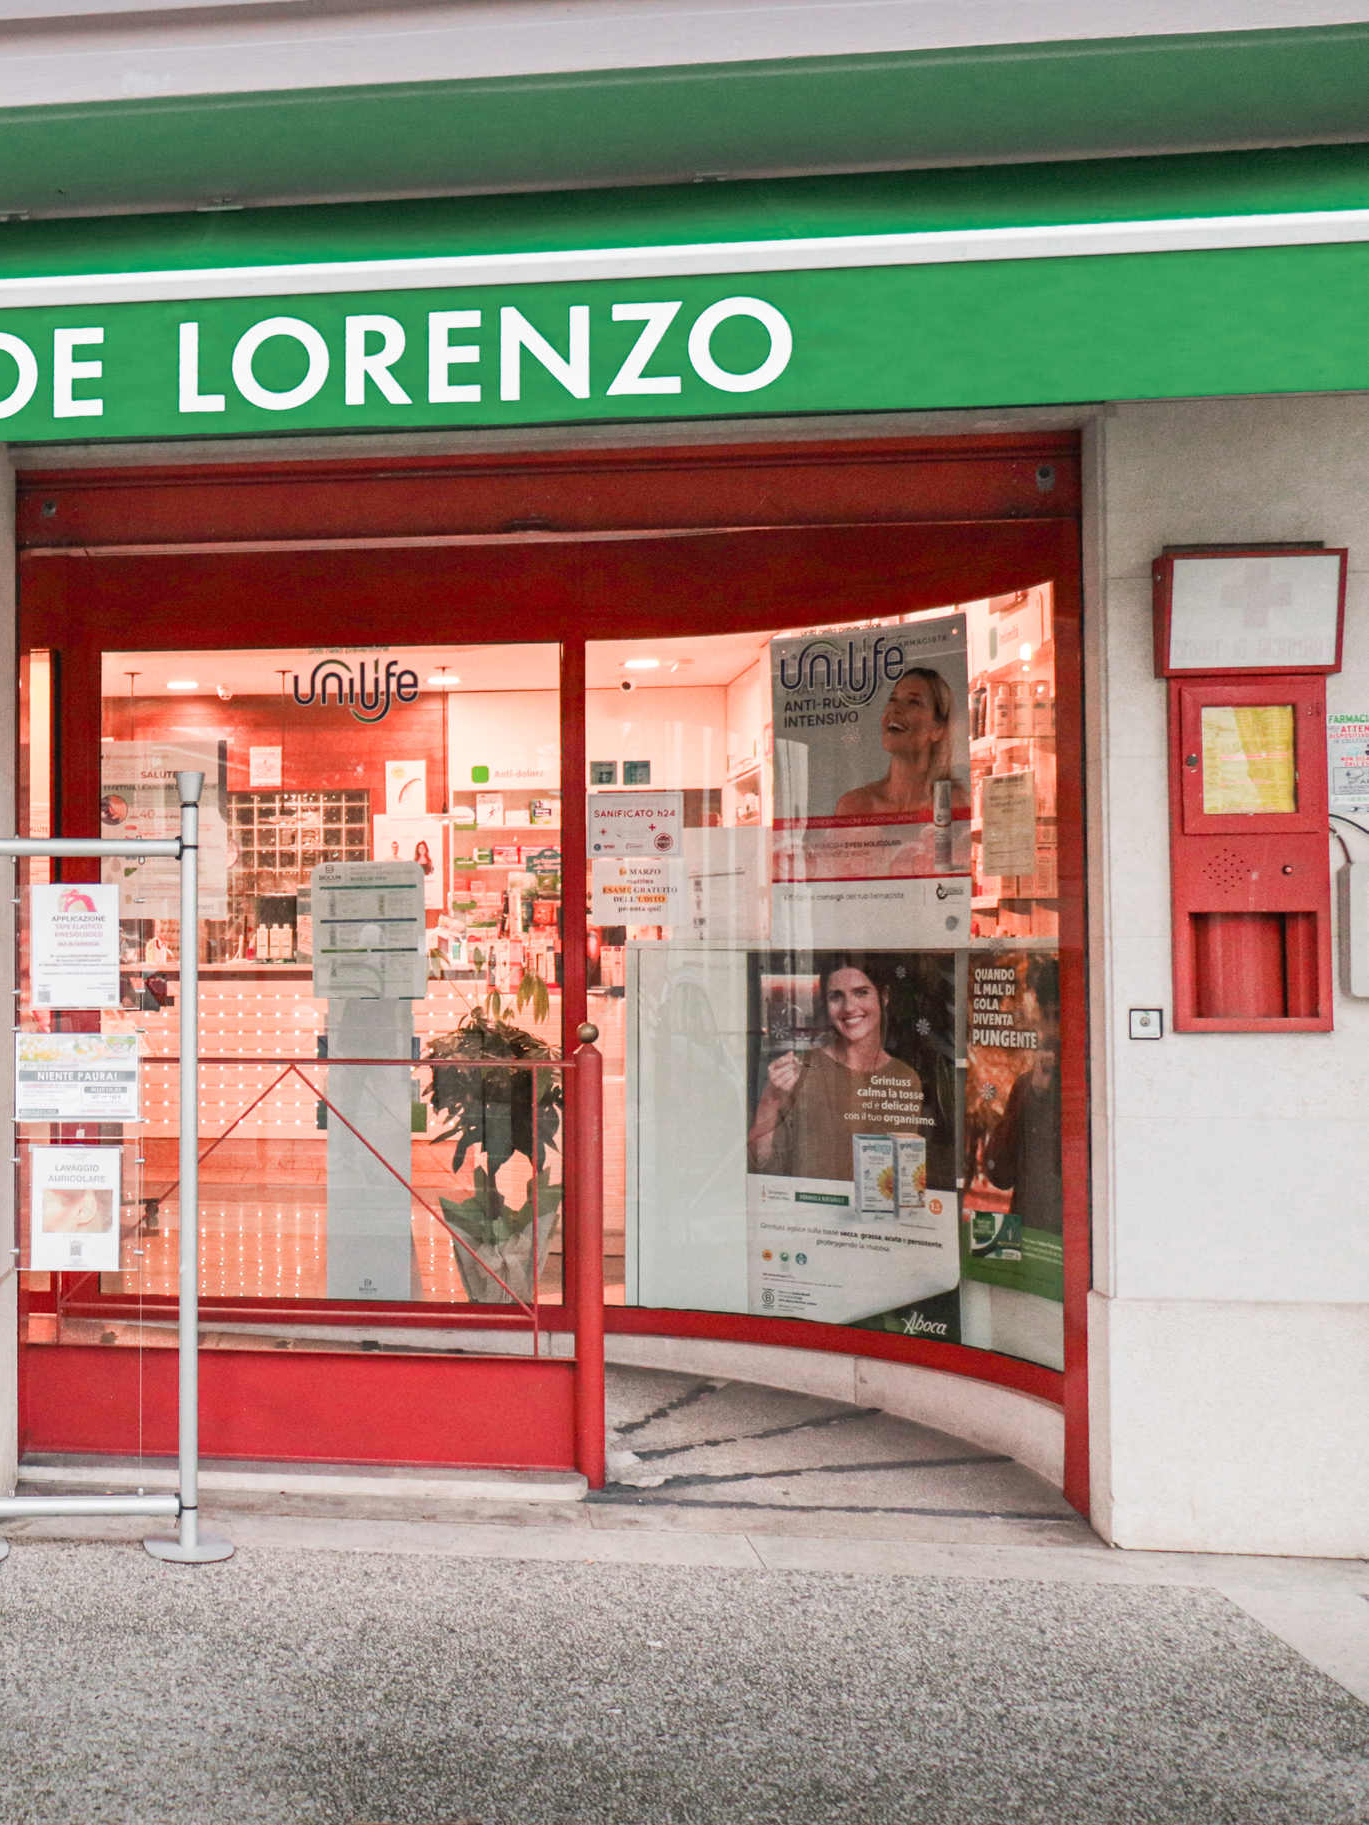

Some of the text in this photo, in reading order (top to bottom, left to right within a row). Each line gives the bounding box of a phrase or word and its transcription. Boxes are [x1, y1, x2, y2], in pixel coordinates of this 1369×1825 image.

[178, 296, 794, 413] LORENZO
[784, 710, 859, 729] INTENSIVO
[594, 809, 654, 818] SANIFICATO
[974, 967, 1015, 982] QUANDO
[973, 983, 1016, 996] IL MAL DI
[973, 998, 1000, 1011] GOLA
[972, 1013, 1014, 1026] DIVENTA
[972, 1028, 1038, 1049] PUNGENTE
[36, 1071, 74, 1081] NIENTE
[870, 1075, 912, 1087] Grintuss
[856, 1087, 925, 1101] calma la tosse
[862, 1100, 873, 1110] ed
[880, 1101, 920, 1112] delicato
[843, 1111, 860, 1121] con
[861, 1111, 867, 1121] il
[867, 1112, 882, 1121] tuo
[54, 1164, 100, 1172] LAVAGGIO
[900, 1311, 948, 1336] Aboca
